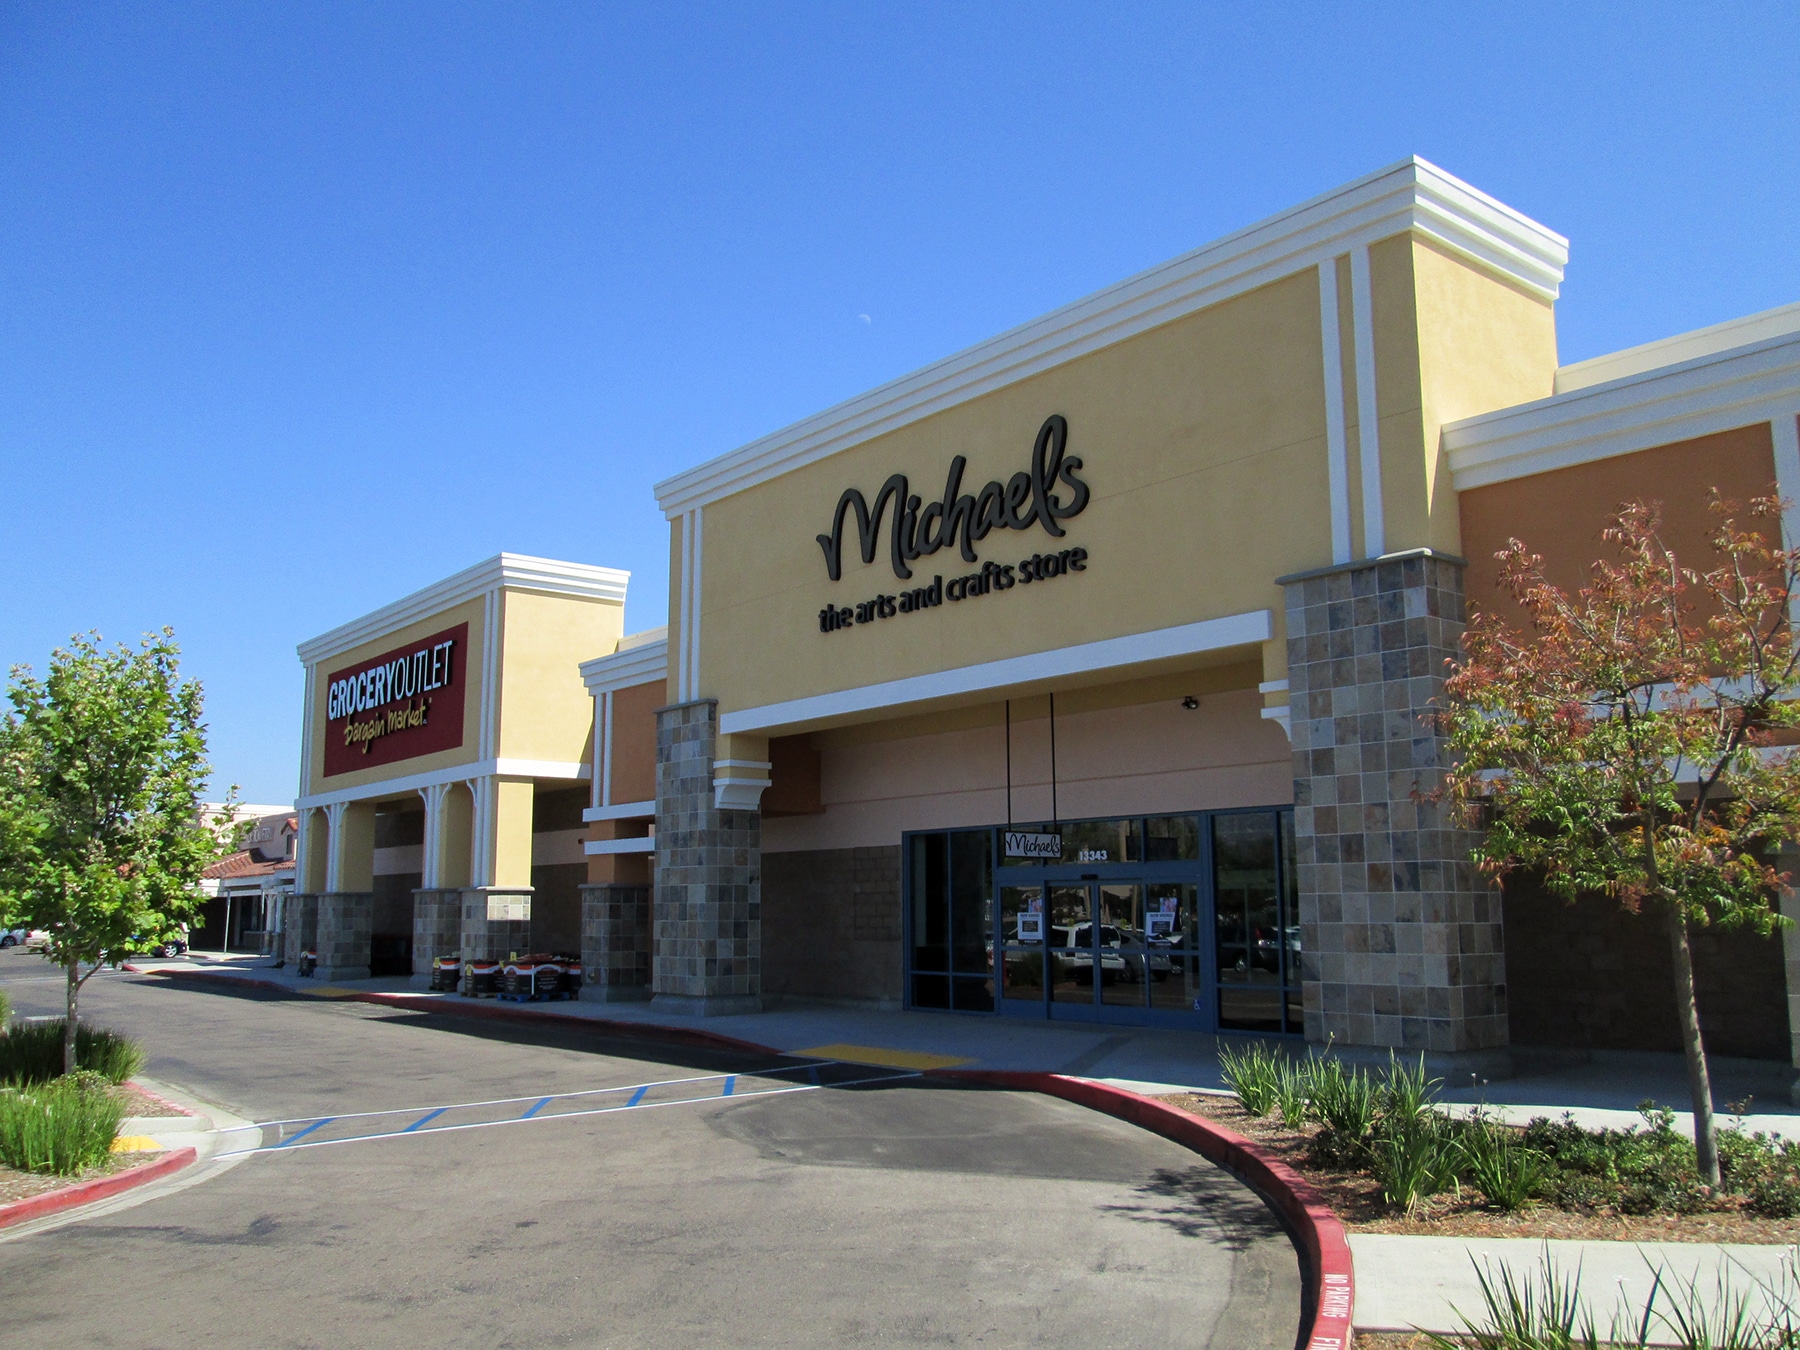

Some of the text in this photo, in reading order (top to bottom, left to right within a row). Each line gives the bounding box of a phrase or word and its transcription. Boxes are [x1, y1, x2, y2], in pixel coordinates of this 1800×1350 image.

[816, 414, 1090, 581] Michaels
[818, 547, 1088, 633] the arts and crafts store
[344, 697, 426, 754] bargain market
[1006, 833, 1060, 856] Michaels
[1080, 850, 1108, 861] 13343
[1321, 1273, 1350, 1318] NO PARKING
